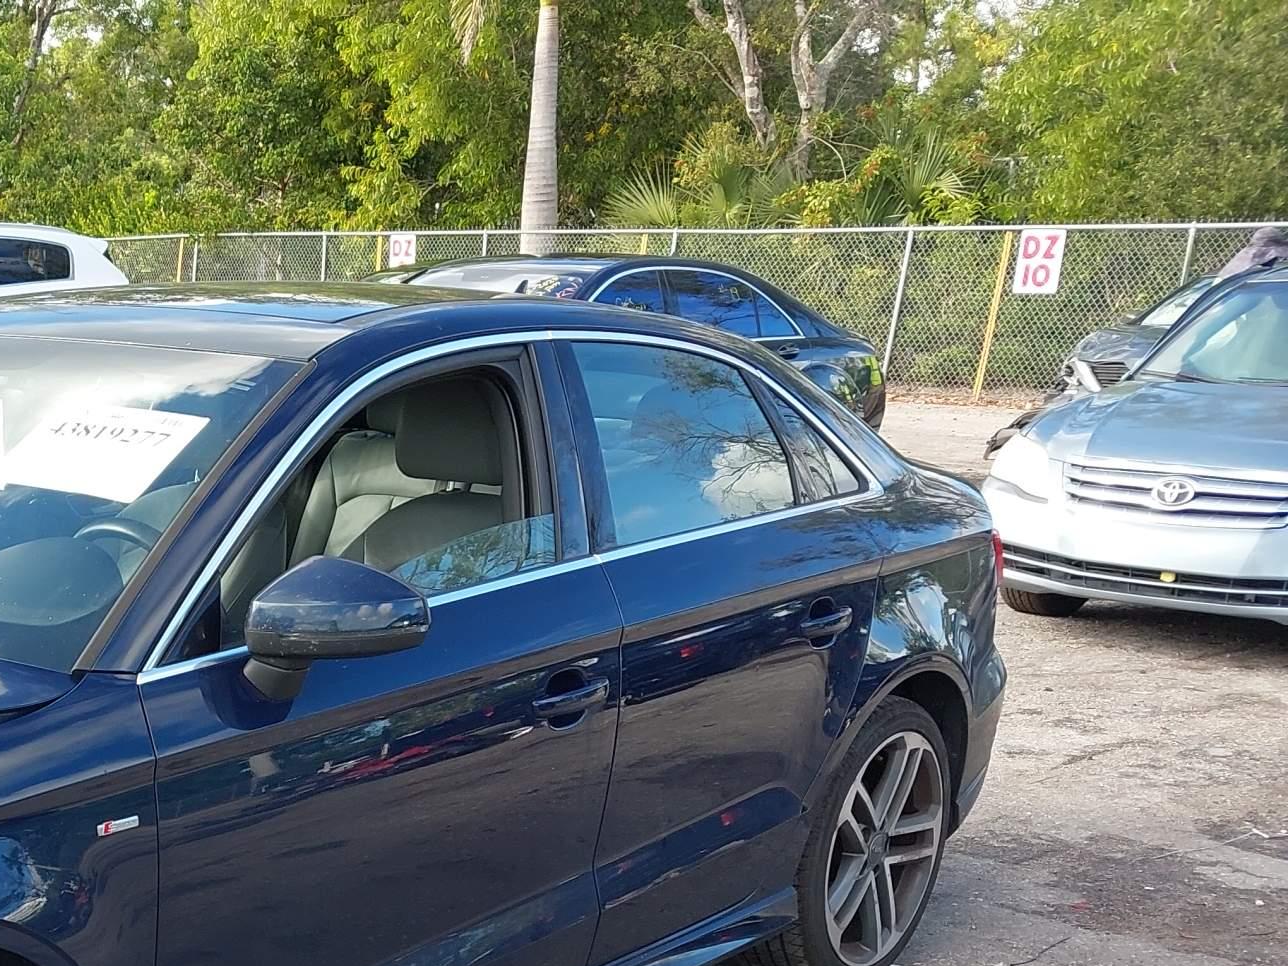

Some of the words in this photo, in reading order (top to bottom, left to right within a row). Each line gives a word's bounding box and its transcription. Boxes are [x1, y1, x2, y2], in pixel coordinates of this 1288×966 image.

[392, 239, 412, 257] DZ
[1022, 235, 1059, 259] DZ
[50, 421, 172, 448] 43819277
